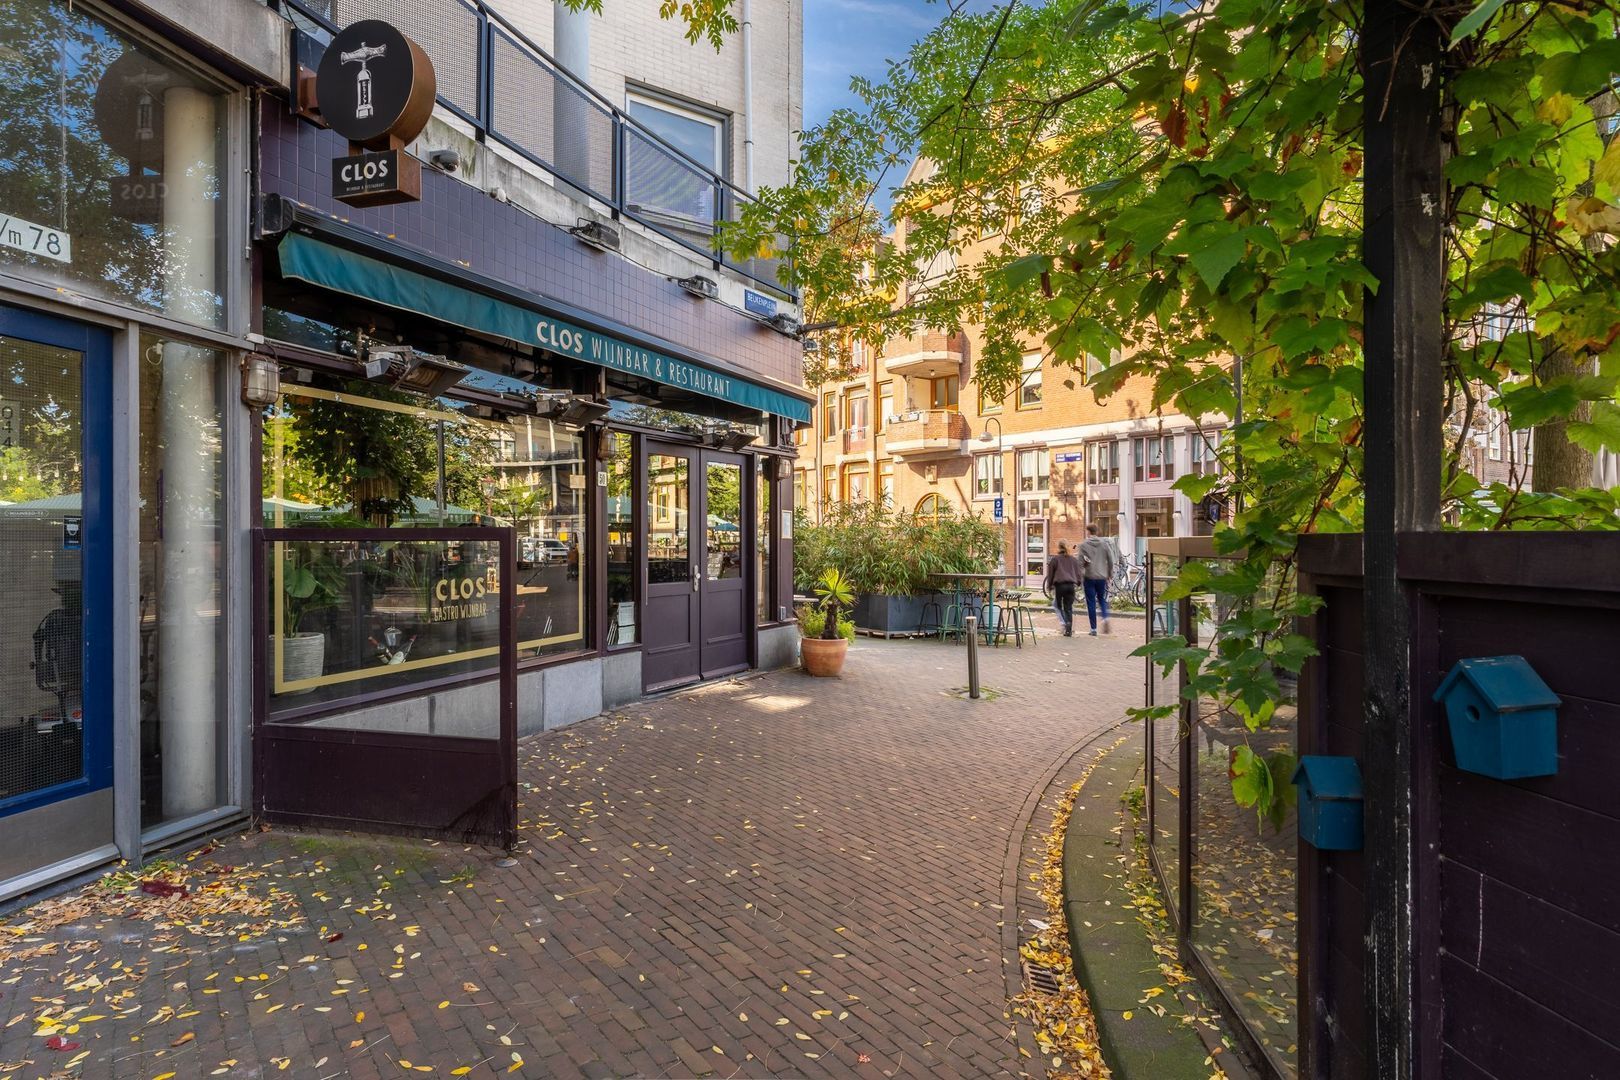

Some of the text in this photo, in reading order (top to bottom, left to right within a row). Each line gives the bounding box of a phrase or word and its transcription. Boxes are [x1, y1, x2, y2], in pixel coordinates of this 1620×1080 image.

[341, 159, 388, 182] CLOS
[29, 225, 61, 255] 78
[536, 321, 730, 397] CLOS WIJNBAR & RESTAURANT
[436, 576, 486, 602] CLOS
[460, 602, 487, 618] WIJNBAR
